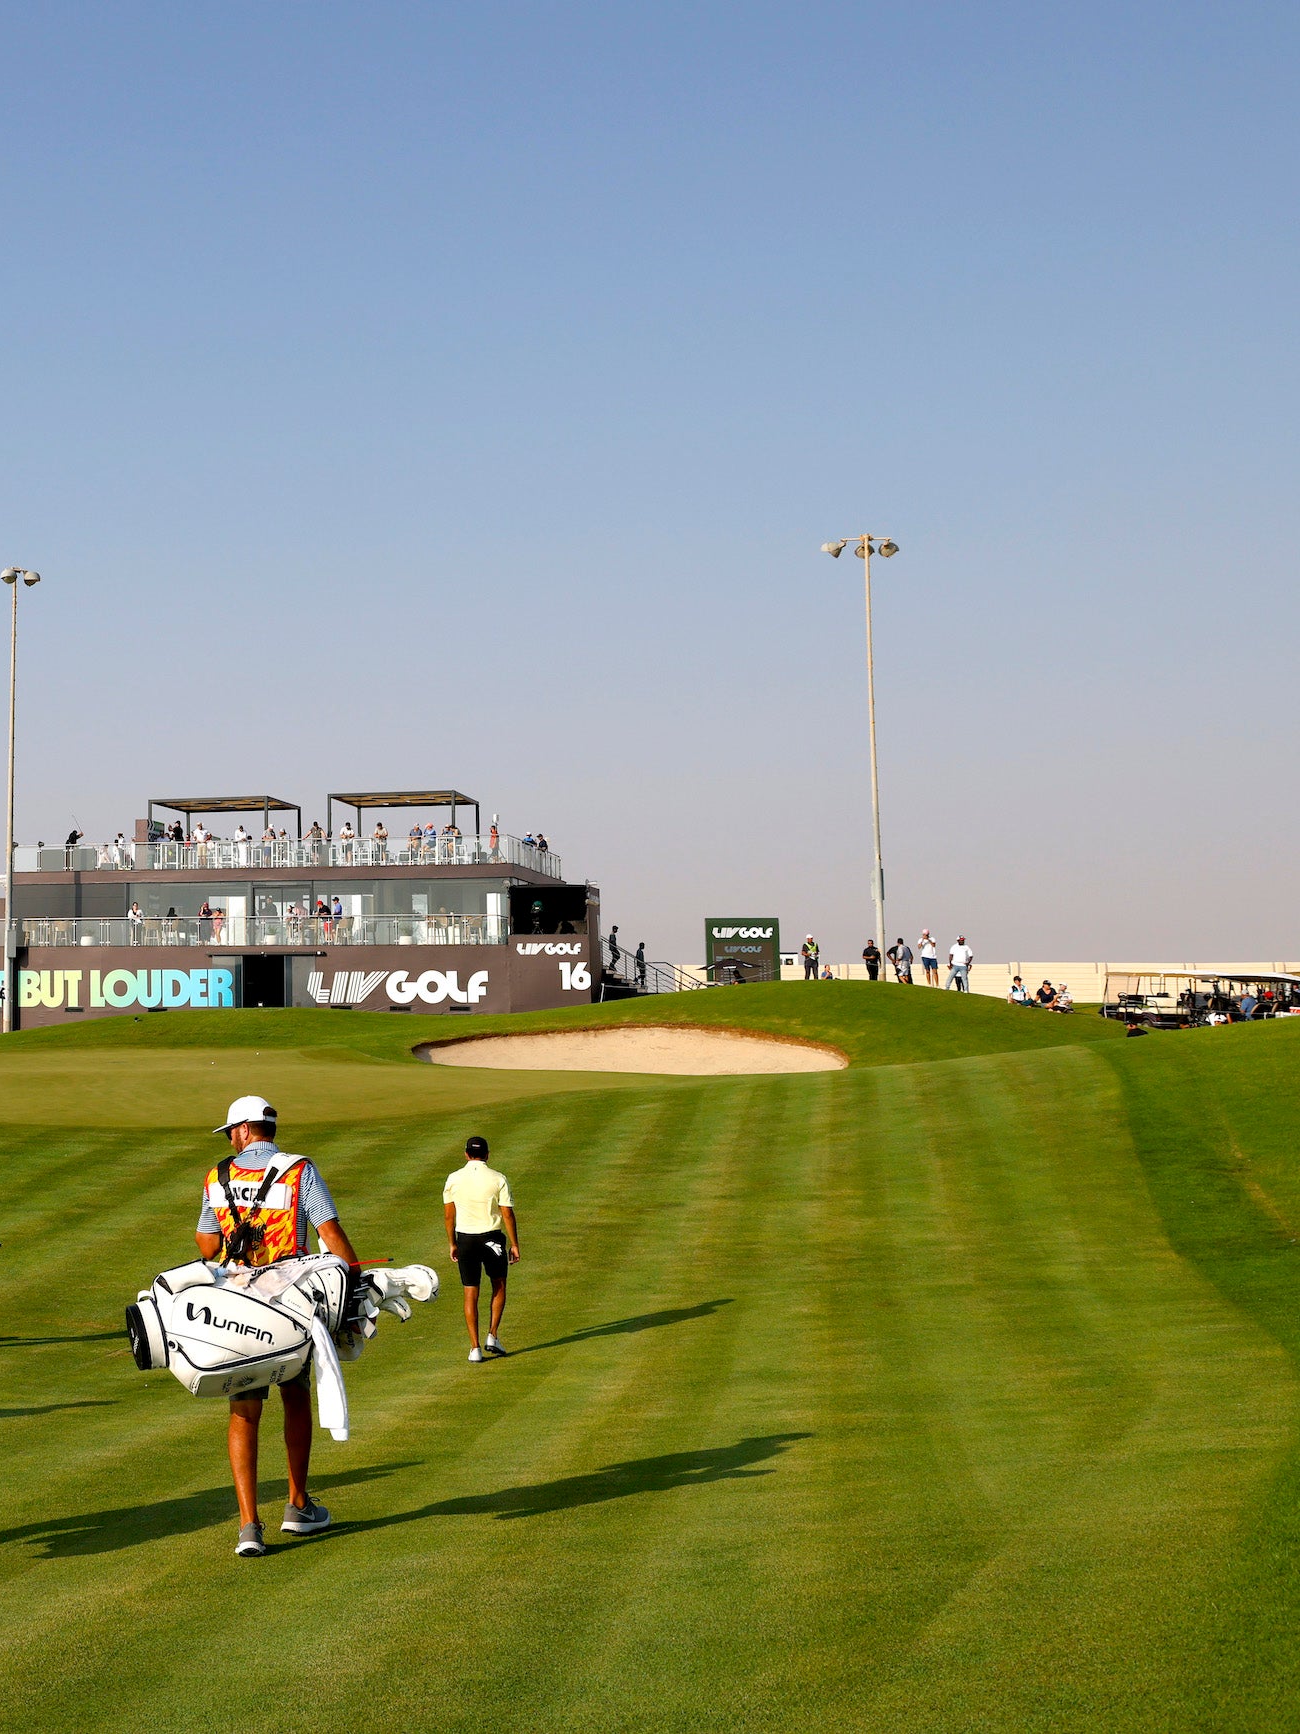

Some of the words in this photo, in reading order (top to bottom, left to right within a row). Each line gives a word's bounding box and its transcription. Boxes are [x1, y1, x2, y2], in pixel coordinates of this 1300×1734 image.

[18, 969, 82, 1008] BUT
[90, 969, 233, 1008] LOUDER
[385, 970, 489, 1004] GOLF
[558, 962, 592, 990] 16
